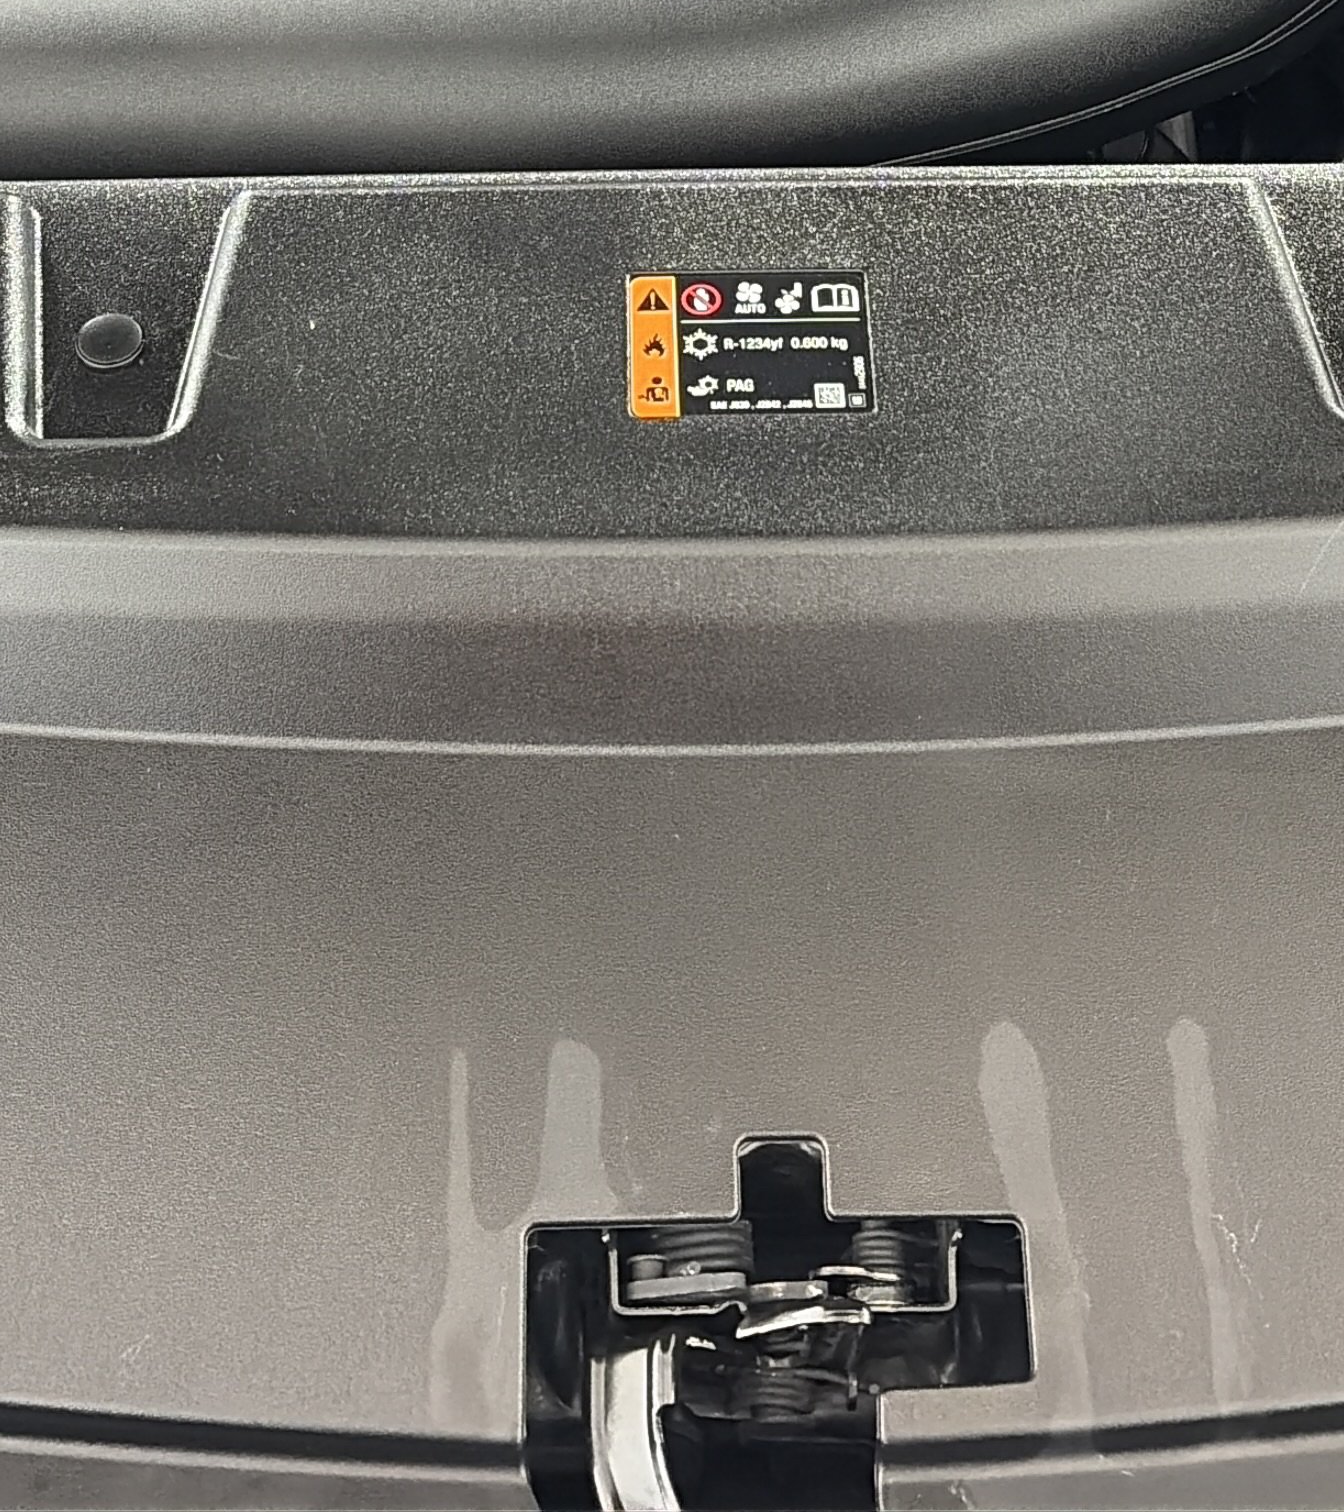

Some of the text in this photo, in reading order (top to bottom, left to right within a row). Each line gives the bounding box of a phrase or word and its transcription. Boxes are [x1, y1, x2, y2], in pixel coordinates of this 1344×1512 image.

[734, 302, 767, 315] AUTO
[723, 336, 849, 352] R-1234yf 0.600 kg
[726, 378, 755, 393] PAG
